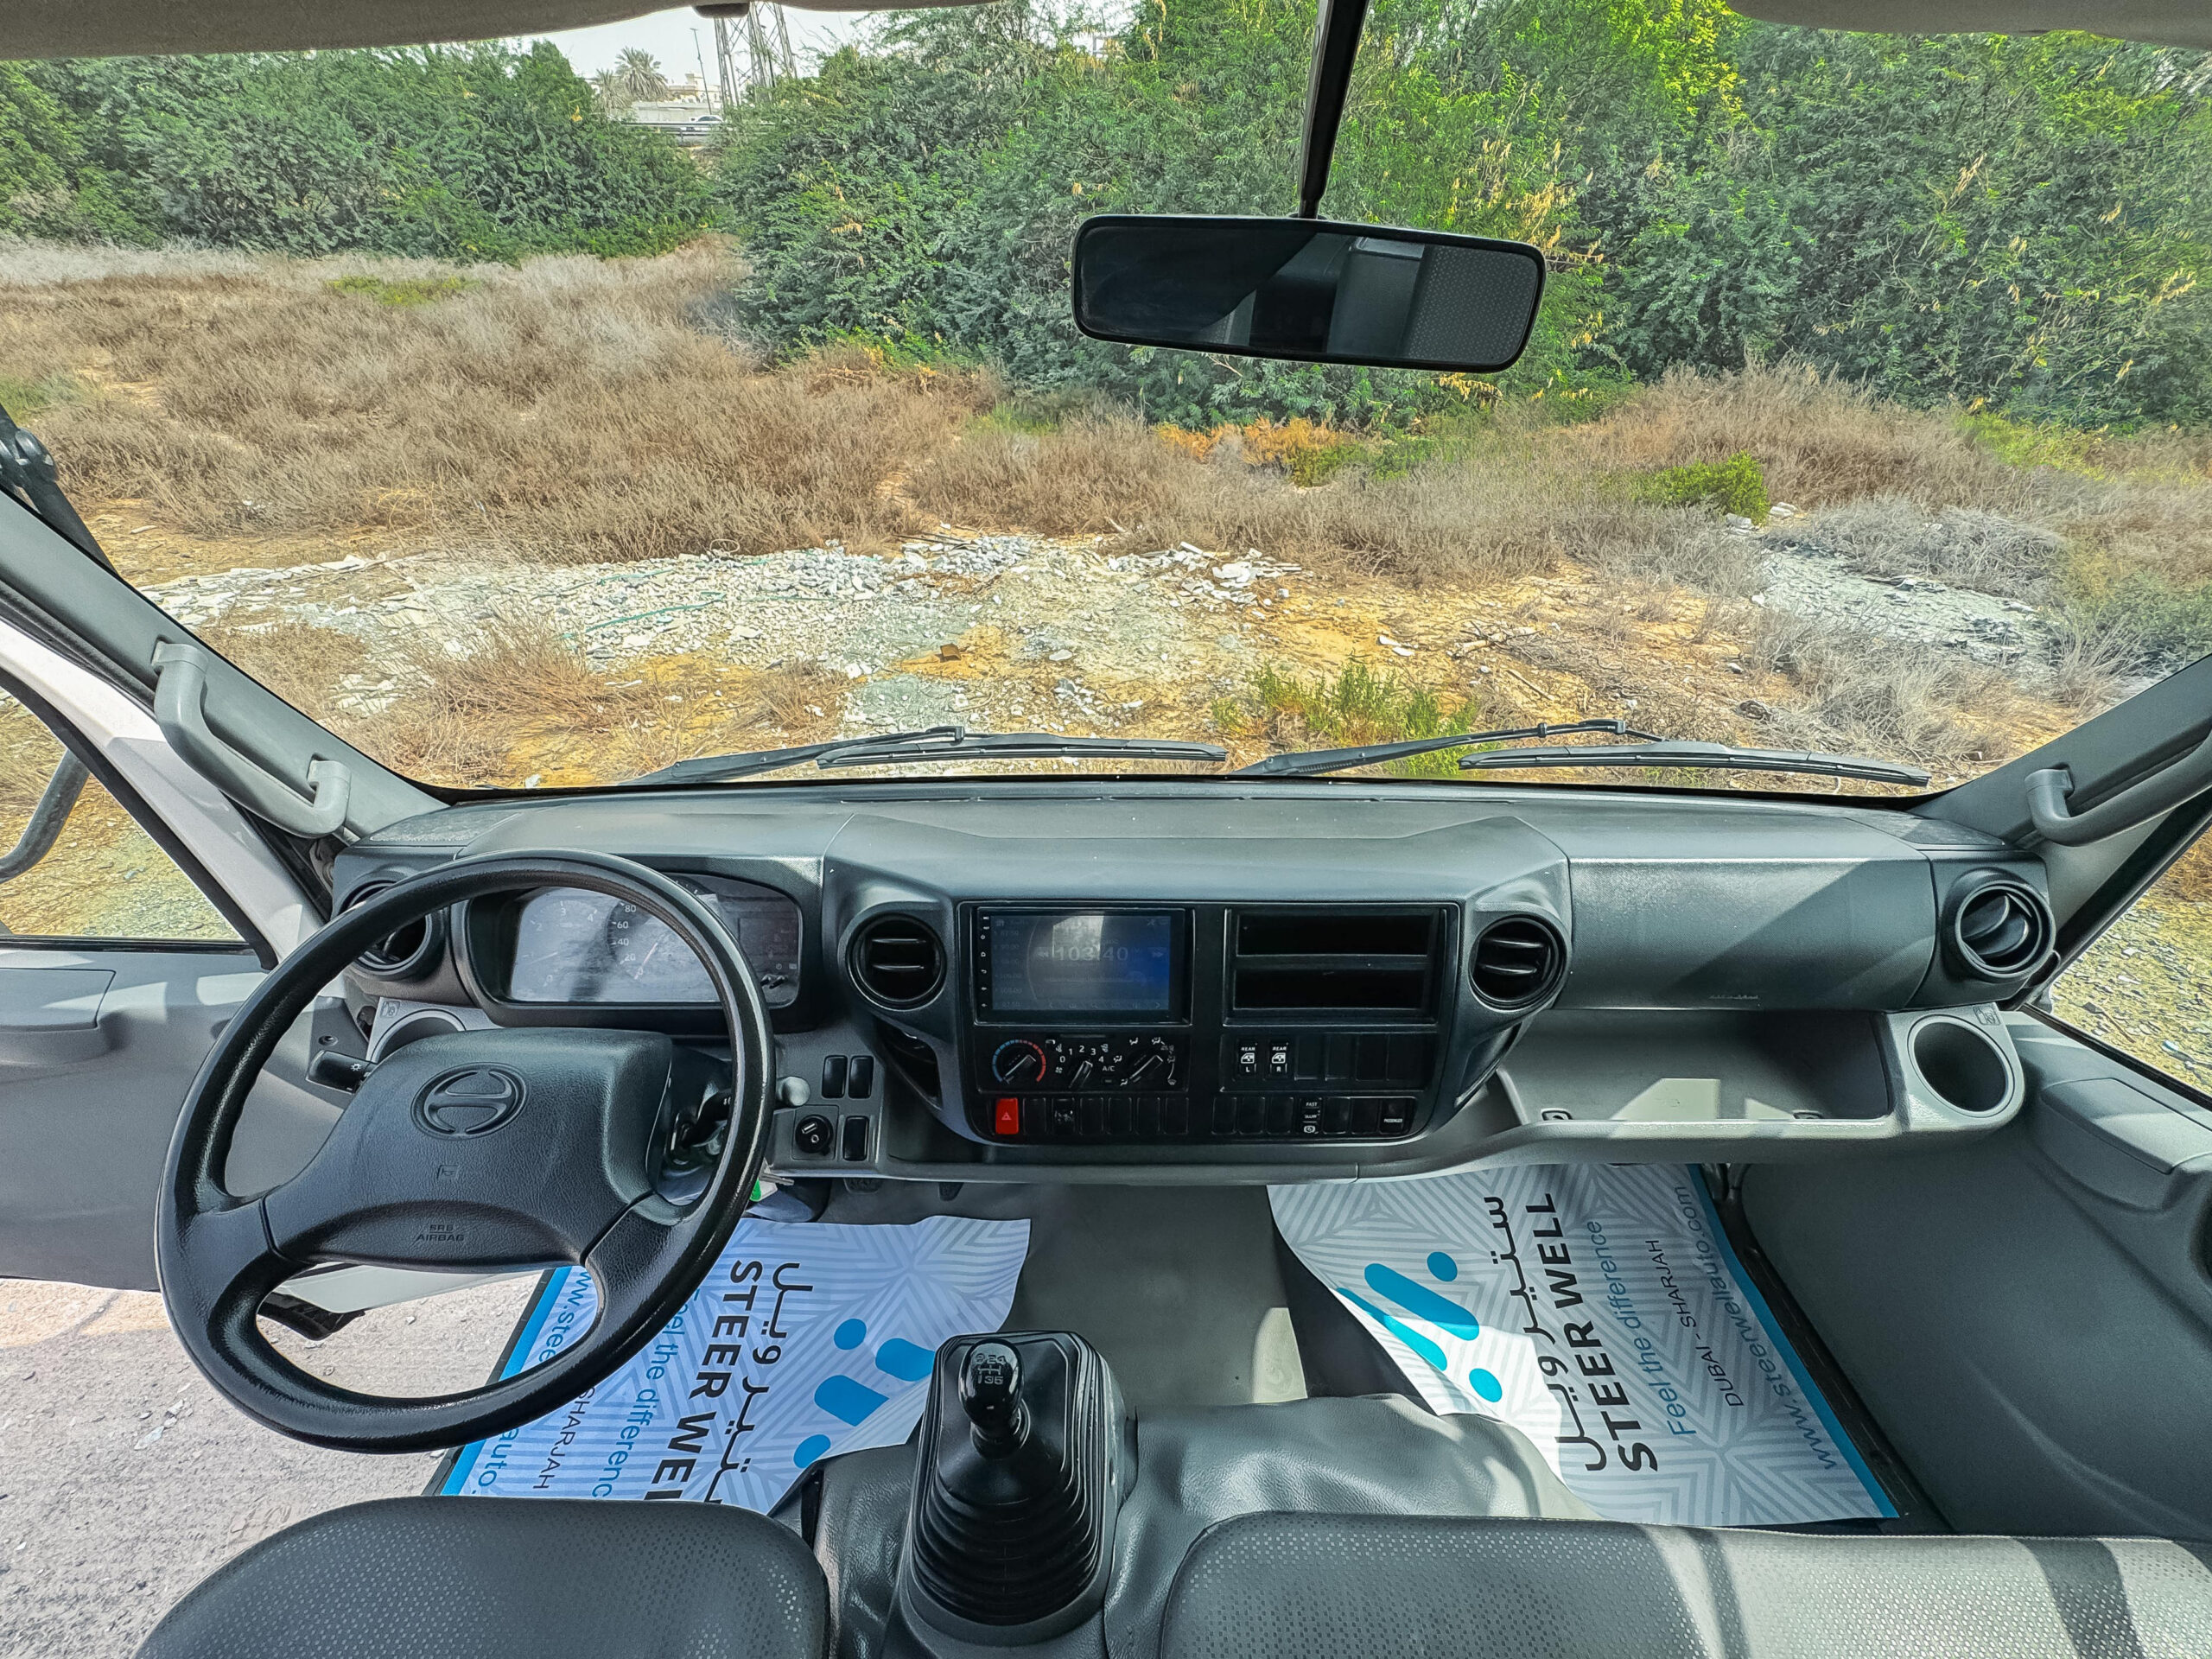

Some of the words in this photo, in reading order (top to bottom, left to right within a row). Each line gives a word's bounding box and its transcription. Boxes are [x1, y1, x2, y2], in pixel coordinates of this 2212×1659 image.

[625, 905, 637, 913] 80
[1078, 1045, 1085, 1053] 2
[1525, 1192, 1584, 1309] WELL
[1586, 1220, 1641, 1330] difference
[1644, 1239, 1697, 1328] SHARJAH
[645, 1342, 678, 1381] the
[689, 1259, 763, 1401] STEER
[1633, 1337, 1663, 1374] the
[1675, 1185, 1838, 1470] www.steerwellauto.com
[1695, 1344, 1744, 1407] DUBAI
[592, 1389, 661, 1498] differenc
[705, 1375, 770, 1504] تير
[1563, 1319, 1658, 1472] STEER
[1649, 1382, 1696, 1437] Feel
